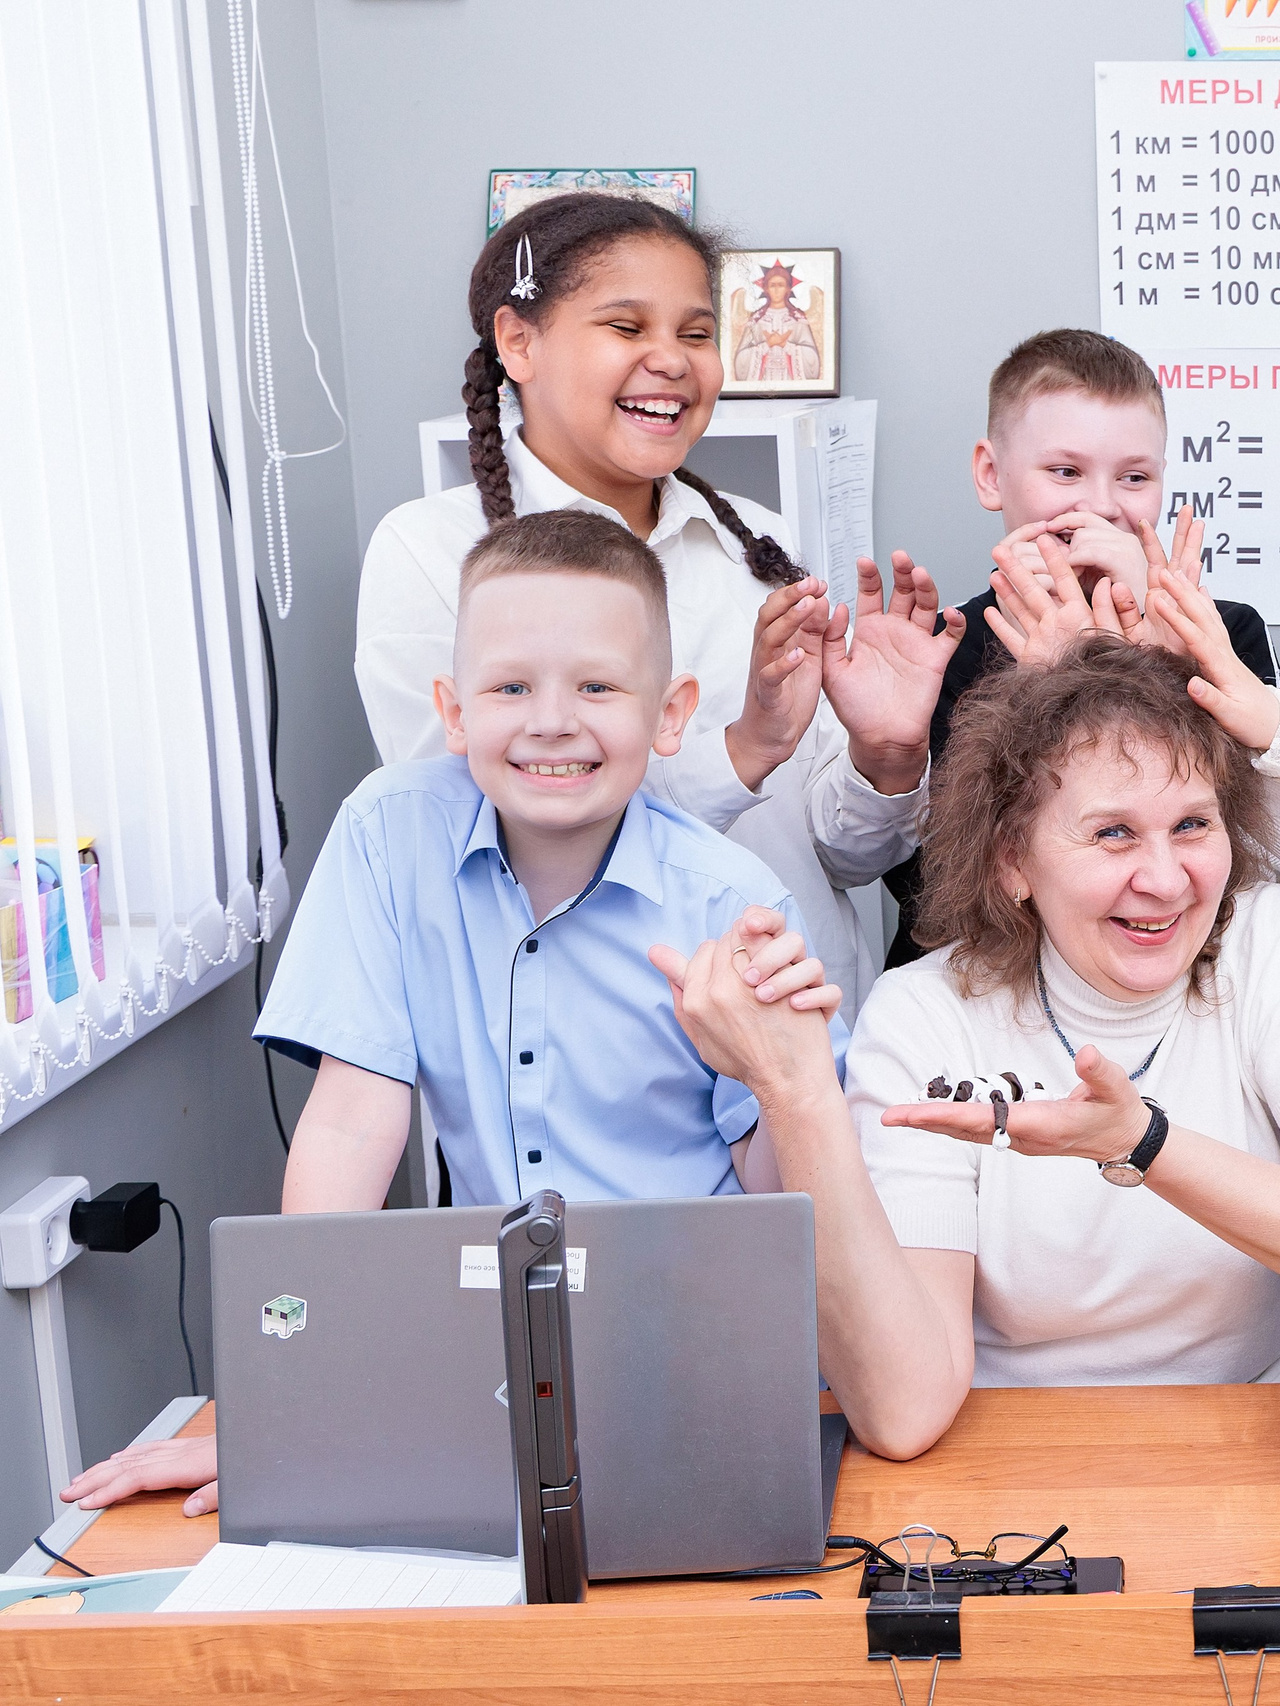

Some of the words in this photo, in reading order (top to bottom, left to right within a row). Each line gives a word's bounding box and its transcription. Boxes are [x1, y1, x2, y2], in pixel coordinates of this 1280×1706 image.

[1161, 80, 1262, 103] МЕРЫ
[1111, 130, 1120, 154] 1
[1136, 137, 1170, 154] км
[1210, 130, 1274, 154] 1000
[1112, 169, 1120, 192] 1
[1137, 175, 1155, 192] м
[1211, 168, 1240, 192] 10
[1112, 207, 1121, 230] 1
[1211, 206, 1240, 230] 10
[1114, 246, 1123, 269] 1
[1138, 252, 1174, 270] см
[1212, 246, 1241, 269] 10
[1114, 282, 1123, 305] 1
[1140, 288, 1157, 305] м
[1212, 281, 1258, 305] 100
[1158, 365, 1258, 389] МЕРЫ
